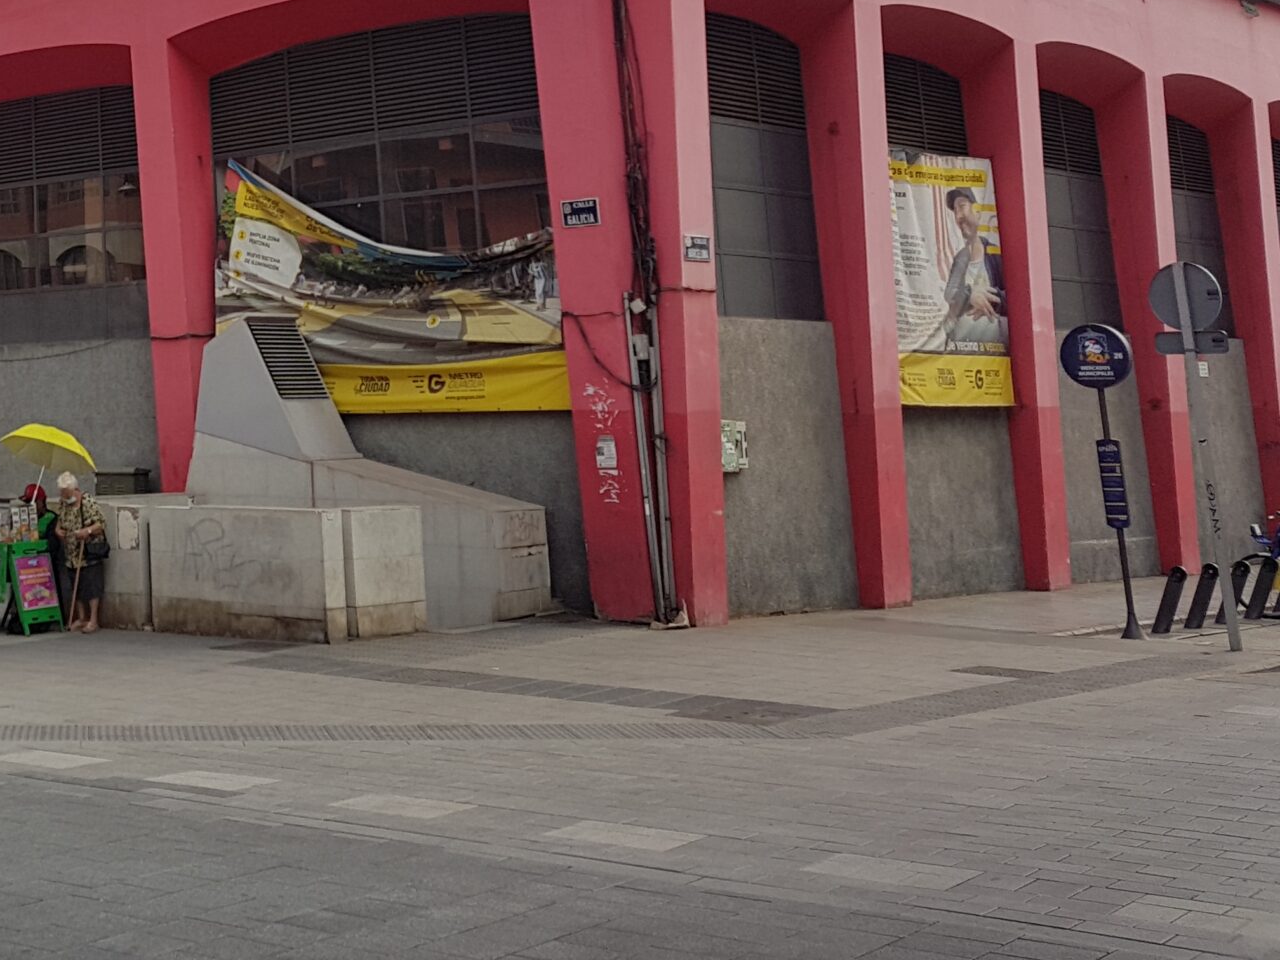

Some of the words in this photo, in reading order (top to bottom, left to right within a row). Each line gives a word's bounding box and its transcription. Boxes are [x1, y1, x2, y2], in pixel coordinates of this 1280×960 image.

[573, 200, 595, 209] CALLE
[567, 213, 595, 225] GALICIA
[448, 372, 483, 380] METRO
[975, 369, 984, 389] G
[359, 382, 390, 393] CIUDAD
[428, 374, 446, 394] G
